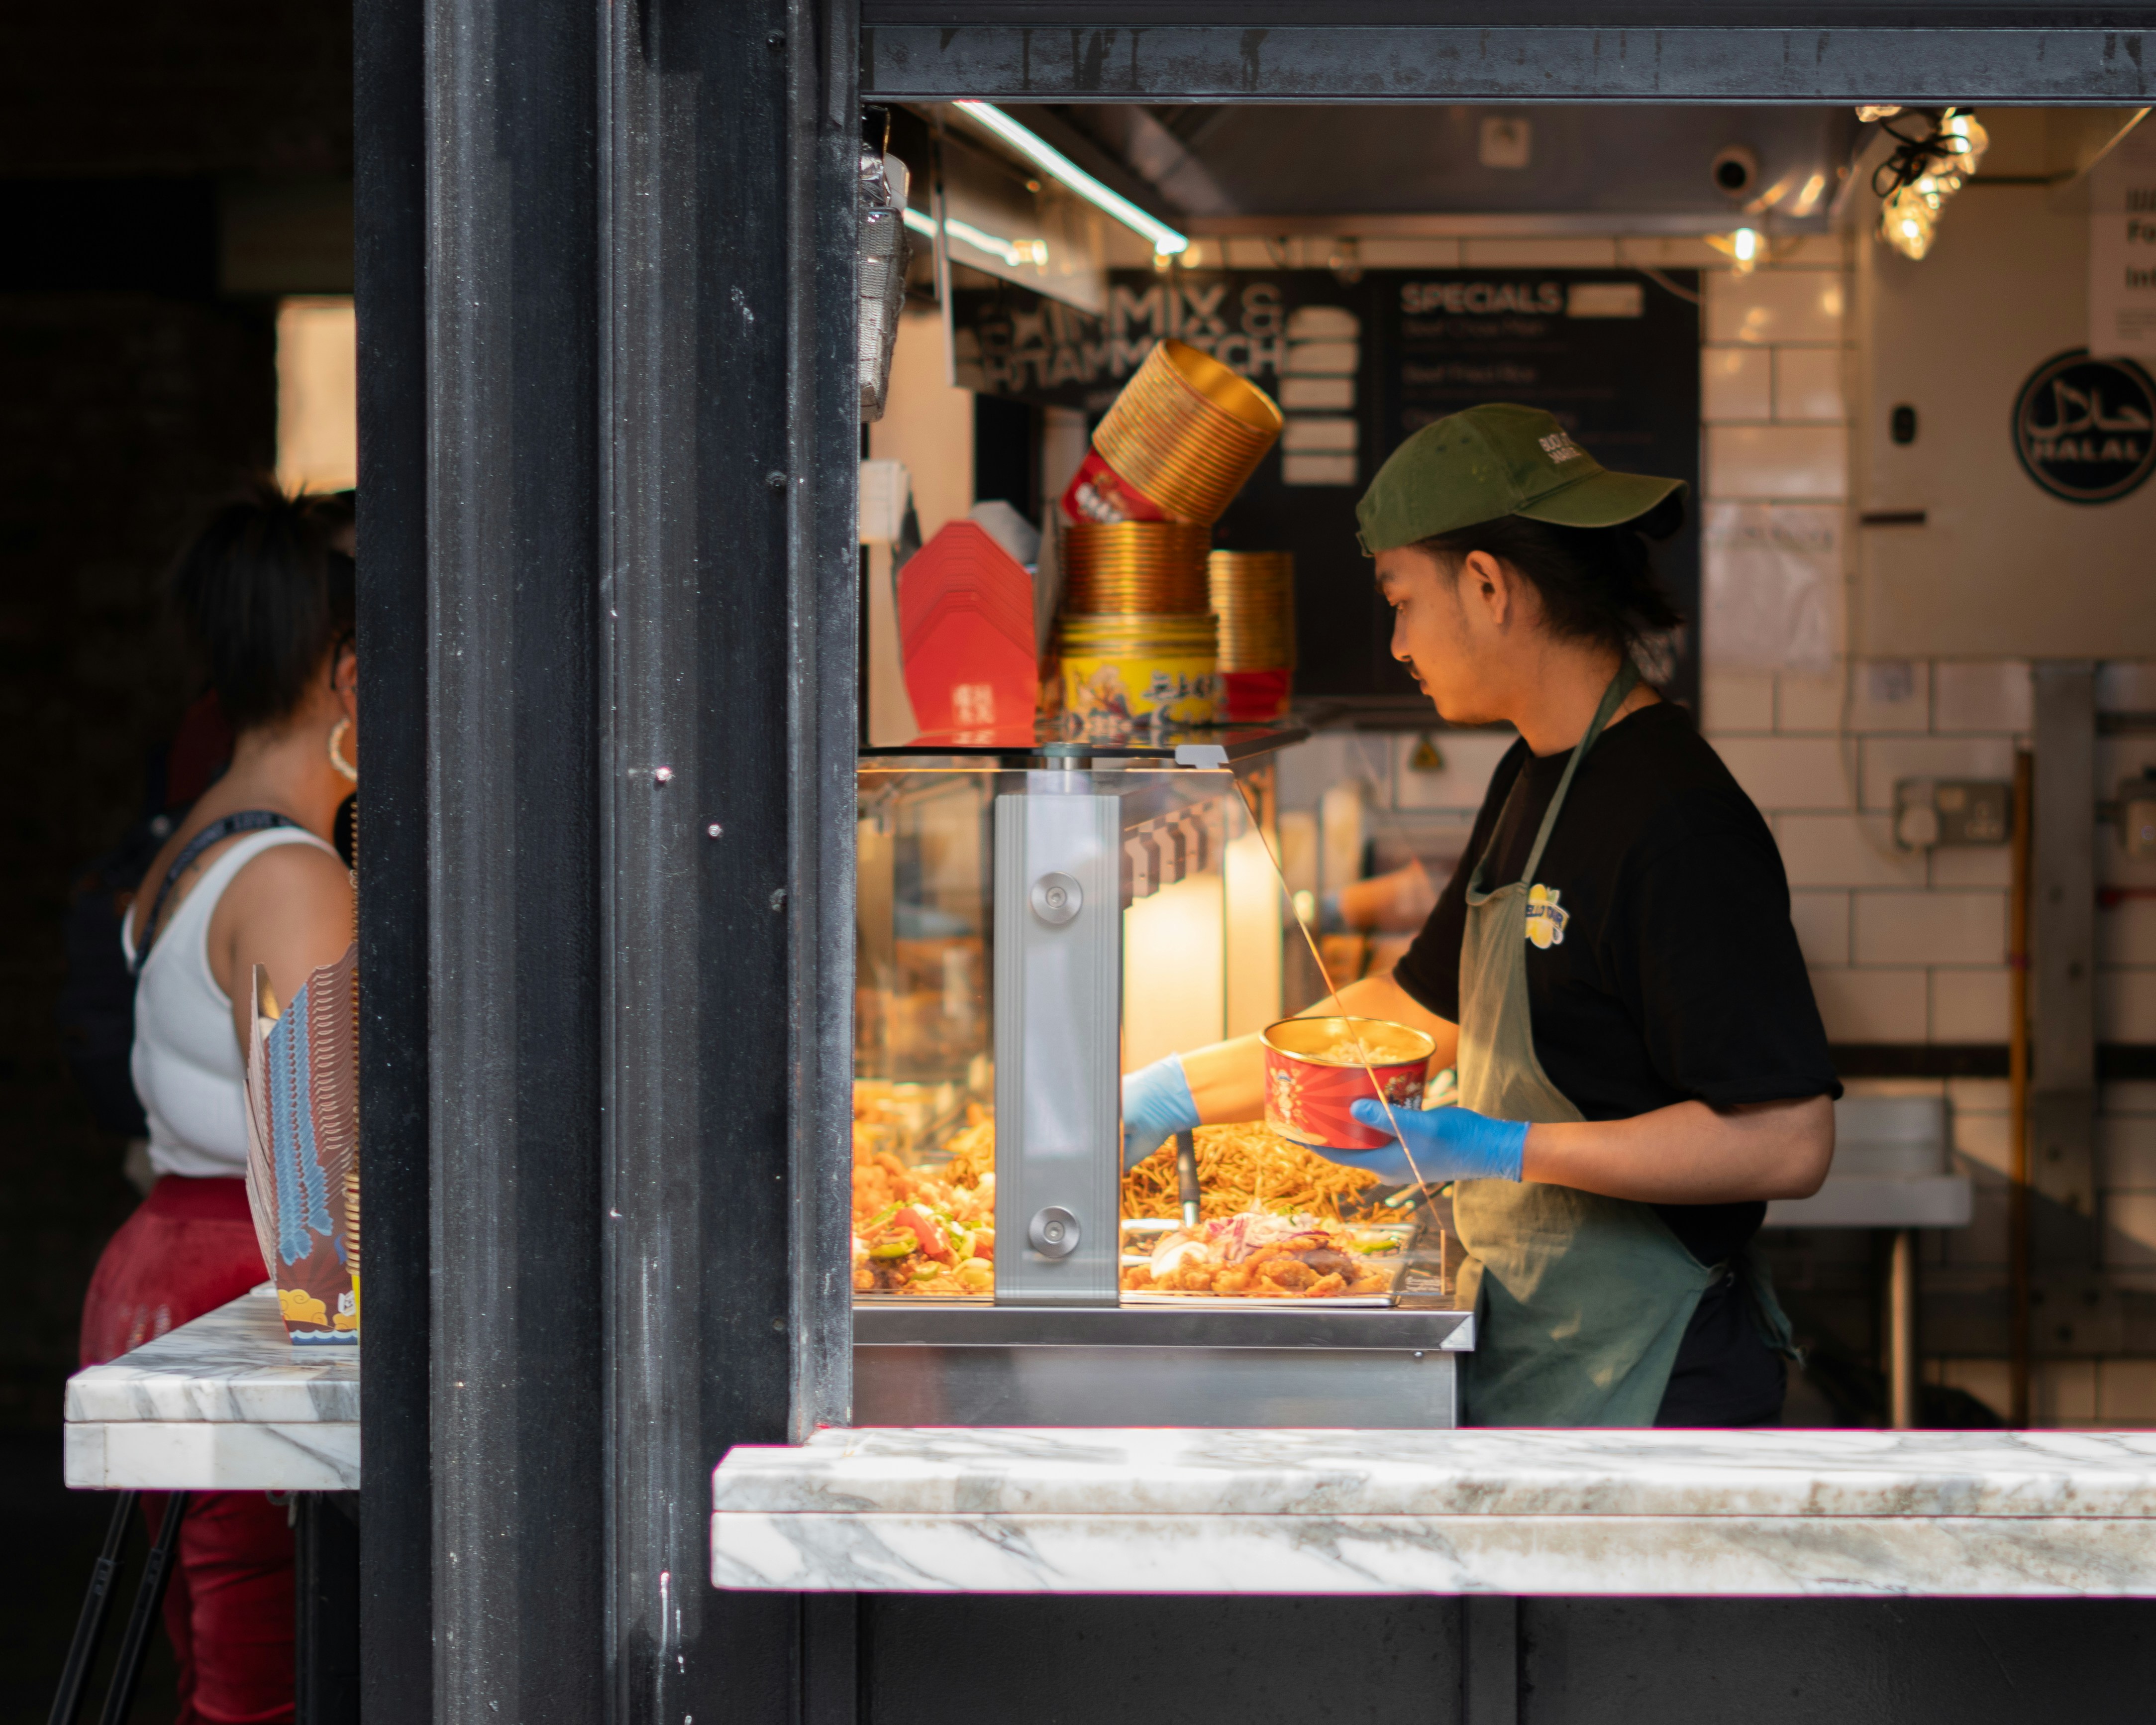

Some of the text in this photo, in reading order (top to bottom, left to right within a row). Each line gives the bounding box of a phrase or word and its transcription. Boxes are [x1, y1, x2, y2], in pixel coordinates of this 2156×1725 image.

[1111, 281, 1284, 339] MIX &
[1400, 282, 1562, 315] SPECIALS
[2030, 437, 2145, 464] HALAL
